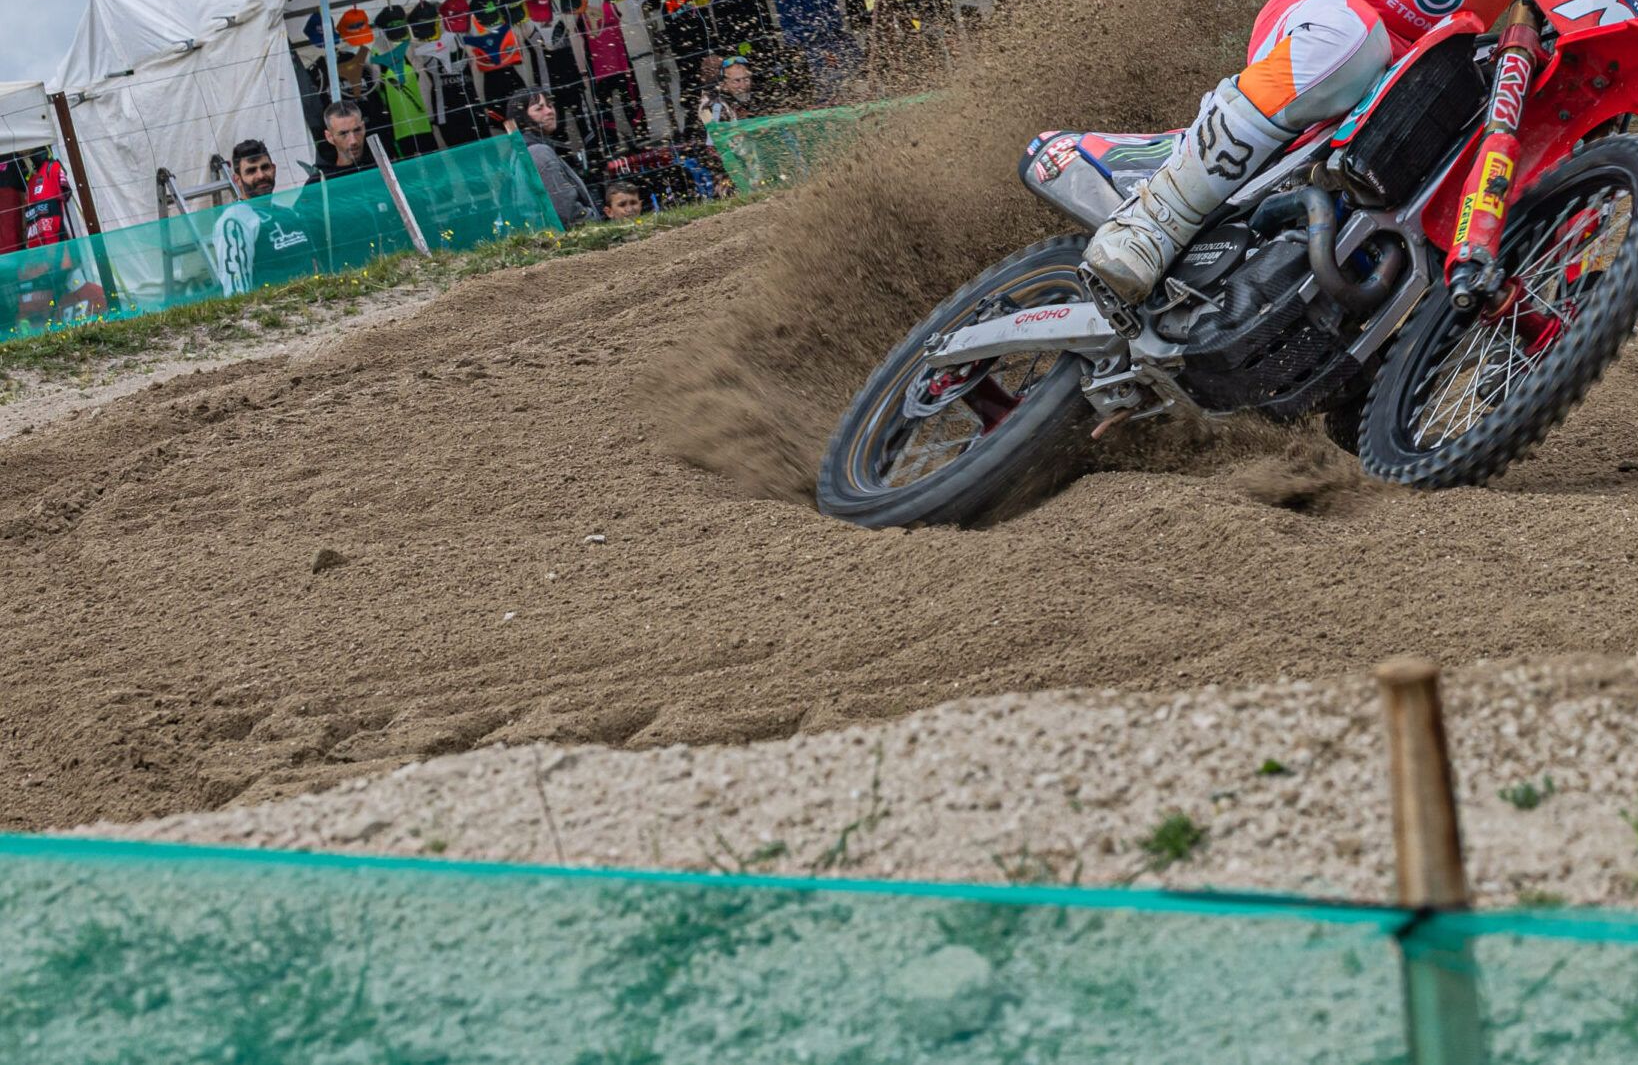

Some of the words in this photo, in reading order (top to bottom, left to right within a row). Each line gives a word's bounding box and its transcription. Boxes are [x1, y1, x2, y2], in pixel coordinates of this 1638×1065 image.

[1493, 53, 1531, 130] KYB
[1455, 195, 1474, 244] ACERBIS
[1189, 241, 1231, 252] HONDA
[1014, 307, 1071, 325] CHOHO
